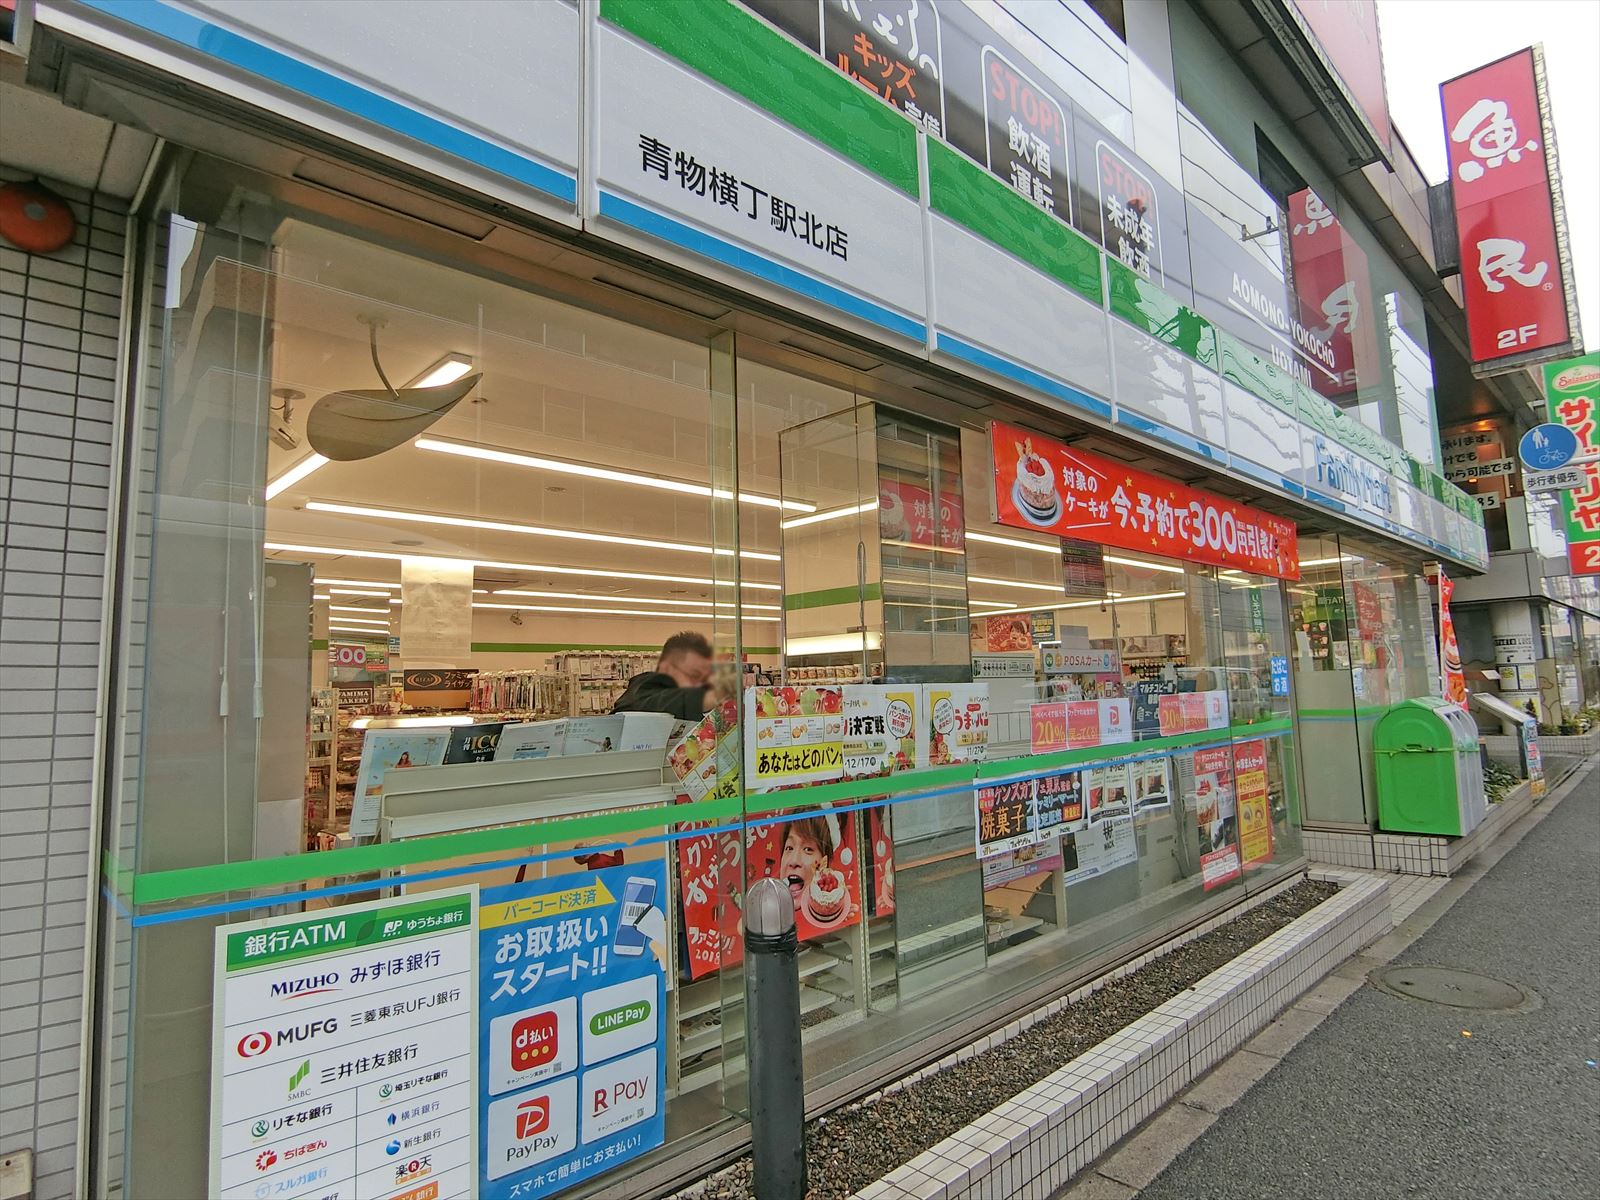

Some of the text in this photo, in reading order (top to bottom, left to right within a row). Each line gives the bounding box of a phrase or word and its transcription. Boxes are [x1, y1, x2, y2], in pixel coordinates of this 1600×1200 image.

[854, 32, 916, 98] キッズ
[990, 61, 1061, 145] STOP!
[1008, 116, 1051, 179] 飲酒
[638, 134, 847, 261] 青物横丁駅北店
[1107, 194, 1154, 251] 未成年
[1496, 323, 1538, 349] 2F
[1063, 466, 1098, 493] 対象の
[1527, 470, 1578, 488] 歩行者優先
[1066, 495, 1109, 519] ケーキが
[844, 714, 885, 737] 決定戦
[1035, 720, 1066, 746] 20%
[981, 804, 1025, 840] 焼菓子
[503, 889, 597, 920] バーコード決済
[407, 911, 463, 930] ゆうちょ銀行
[244, 920, 346, 957] 銀行ATM
[495, 915, 608, 964] お取扱い
[695, 948, 721, 963] 2018
[270, 949, 440, 997] MIZUHO みずほ銀行
[277, 988, 461, 1046] MUFG 三菱東京UFJ銀行
[597, 1006, 645, 1030] LINE Pay
[515, 1025, 554, 1048] d払い
[320, 1043, 418, 1084] 三井住友銀行
[395, 1069, 448, 1092] 埼玉りそな銀行
[613, 1076, 649, 1105] Pay
[288, 1088, 312, 1102] SMBC
[272, 1103, 333, 1130] りそな銀行
[401, 1101, 440, 1121] 横浜銀行
[283, 1140, 328, 1160] ちばぎん
[404, 1128, 442, 1148] 新生銀行
[507, 1134, 559, 1162] PayPay
[510, 1134, 642, 1199] スマホで簡単にお支払い!
[274, 1166, 328, 1195] スルガ銀行
